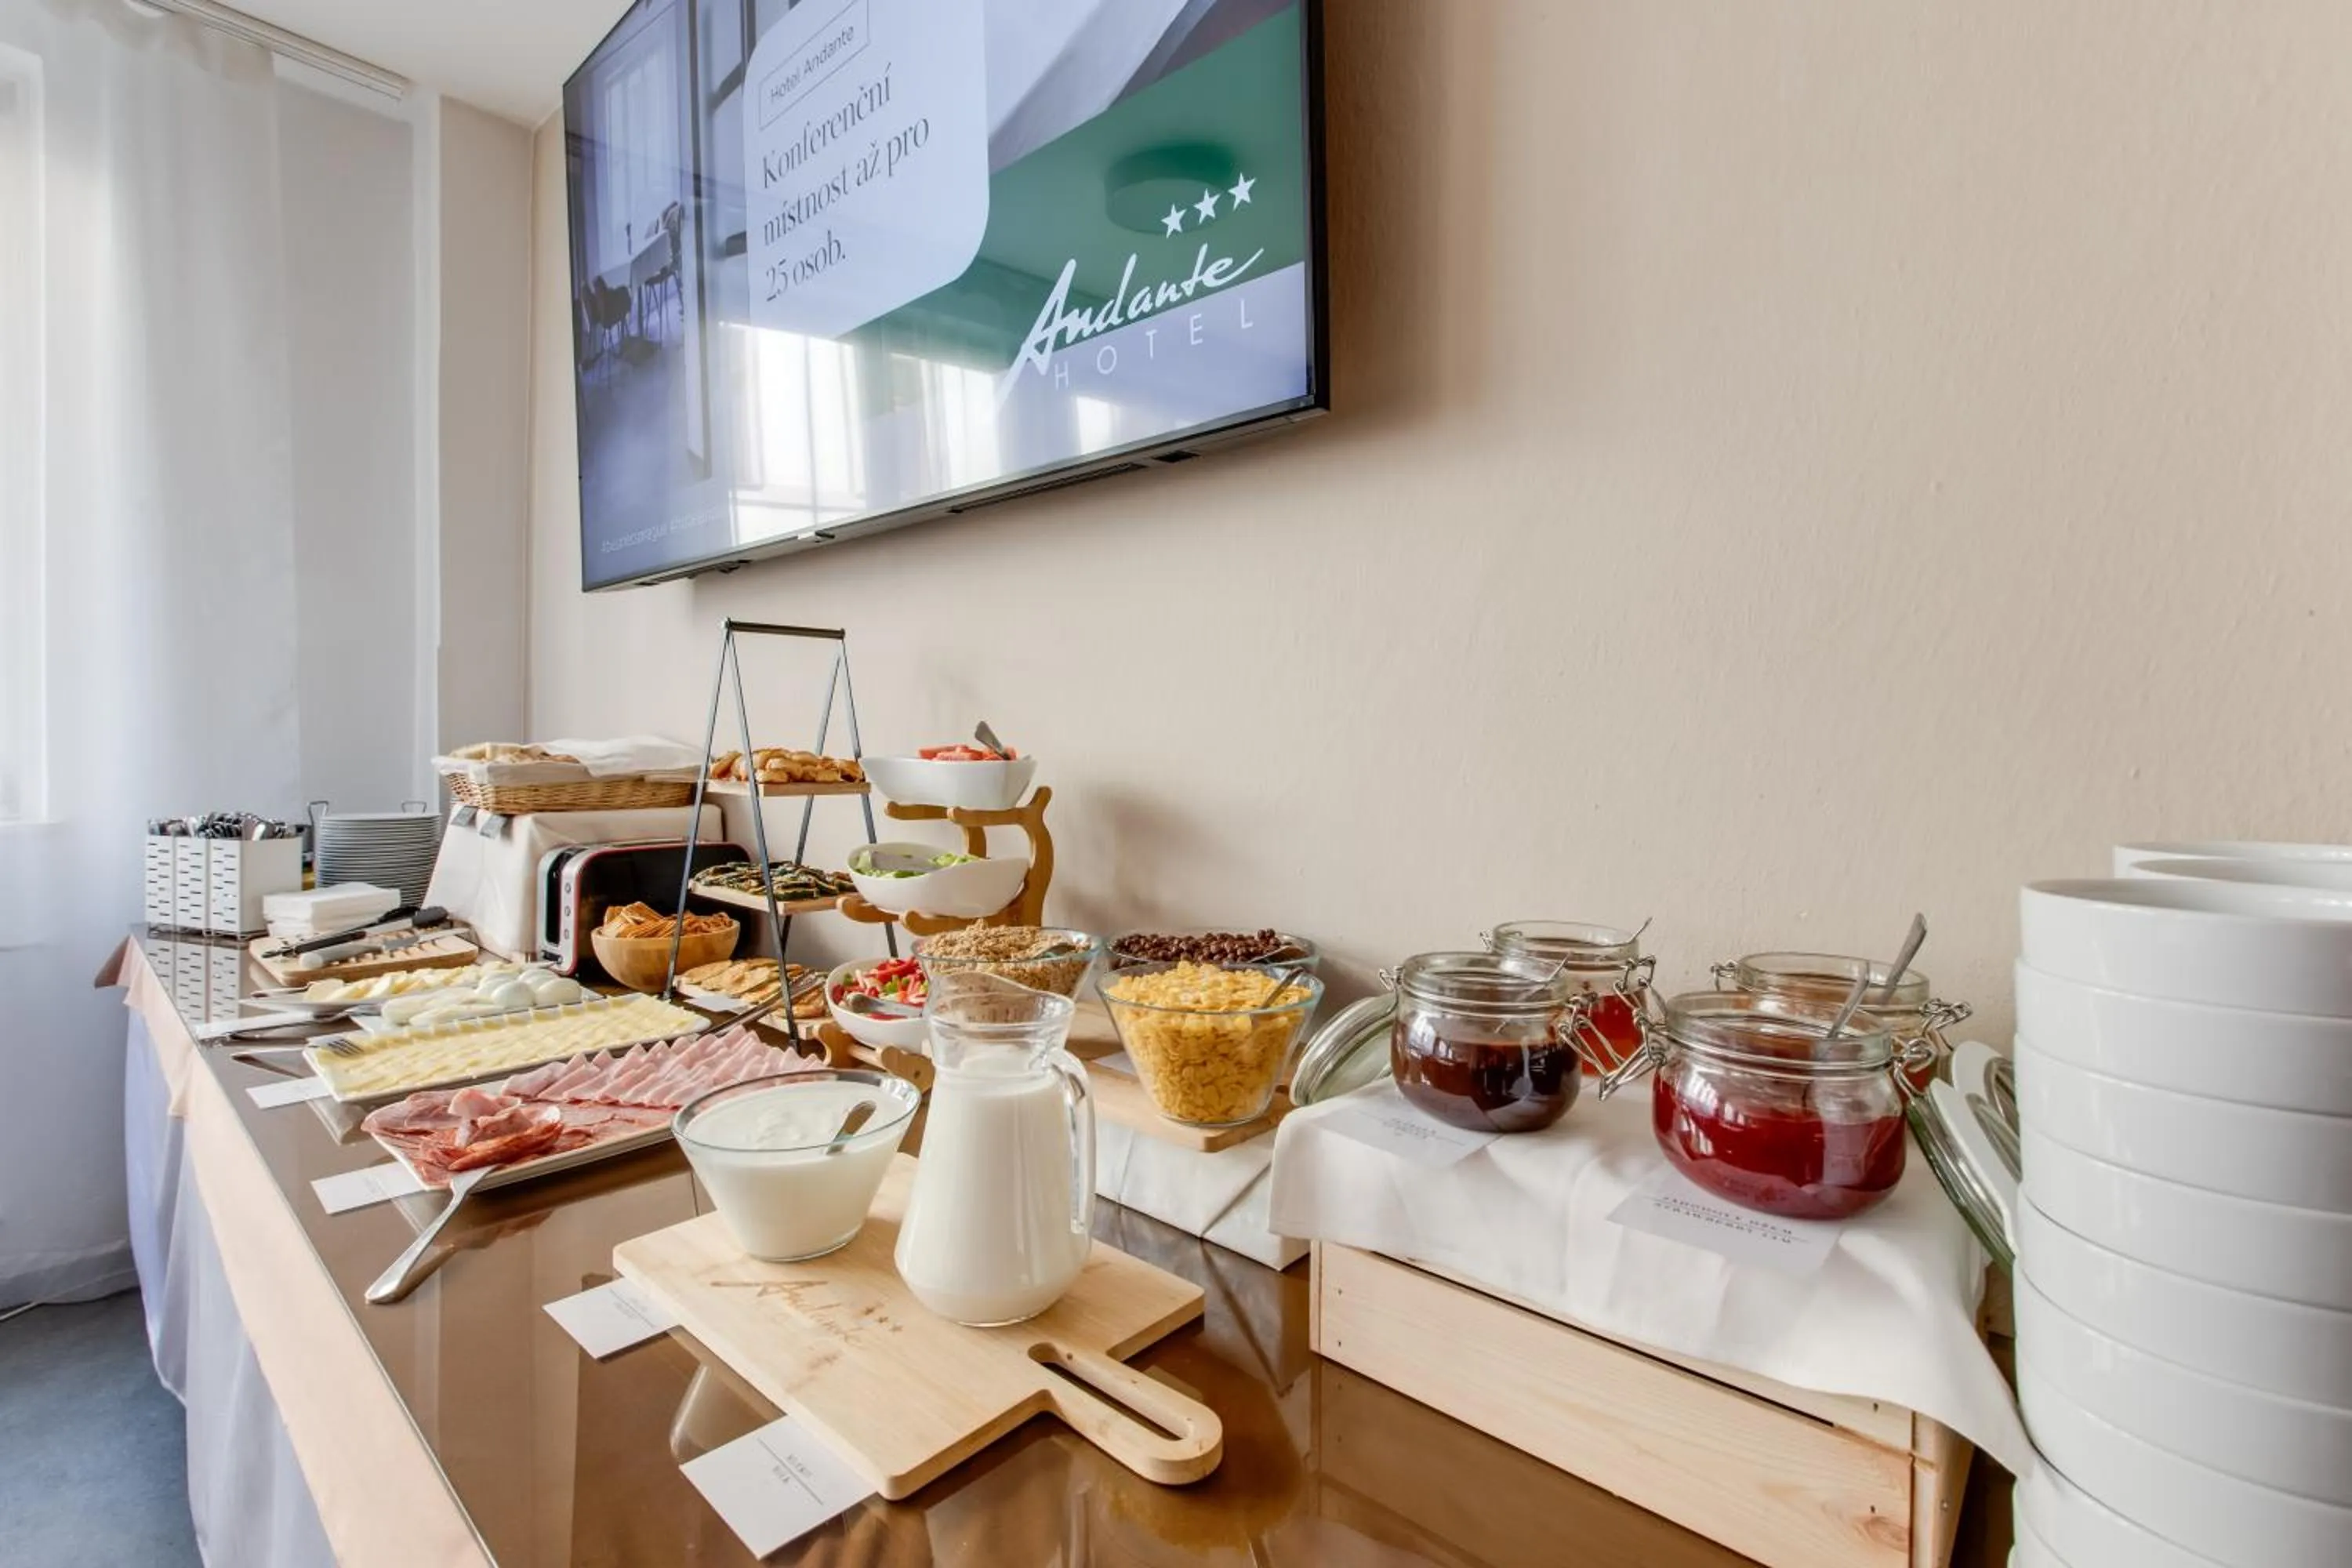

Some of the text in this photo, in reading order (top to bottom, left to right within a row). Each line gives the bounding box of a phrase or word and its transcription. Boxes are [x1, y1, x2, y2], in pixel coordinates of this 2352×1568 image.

[770, 25, 855, 102] Hotel Andante
[763, 62, 891, 188] Konferenční
[764, 118, 930, 245] místnost až pro
[765, 230, 846, 302] 25 osob.
[996, 243, 1265, 408] Andante
[1054, 299, 1253, 390] HOTEL
